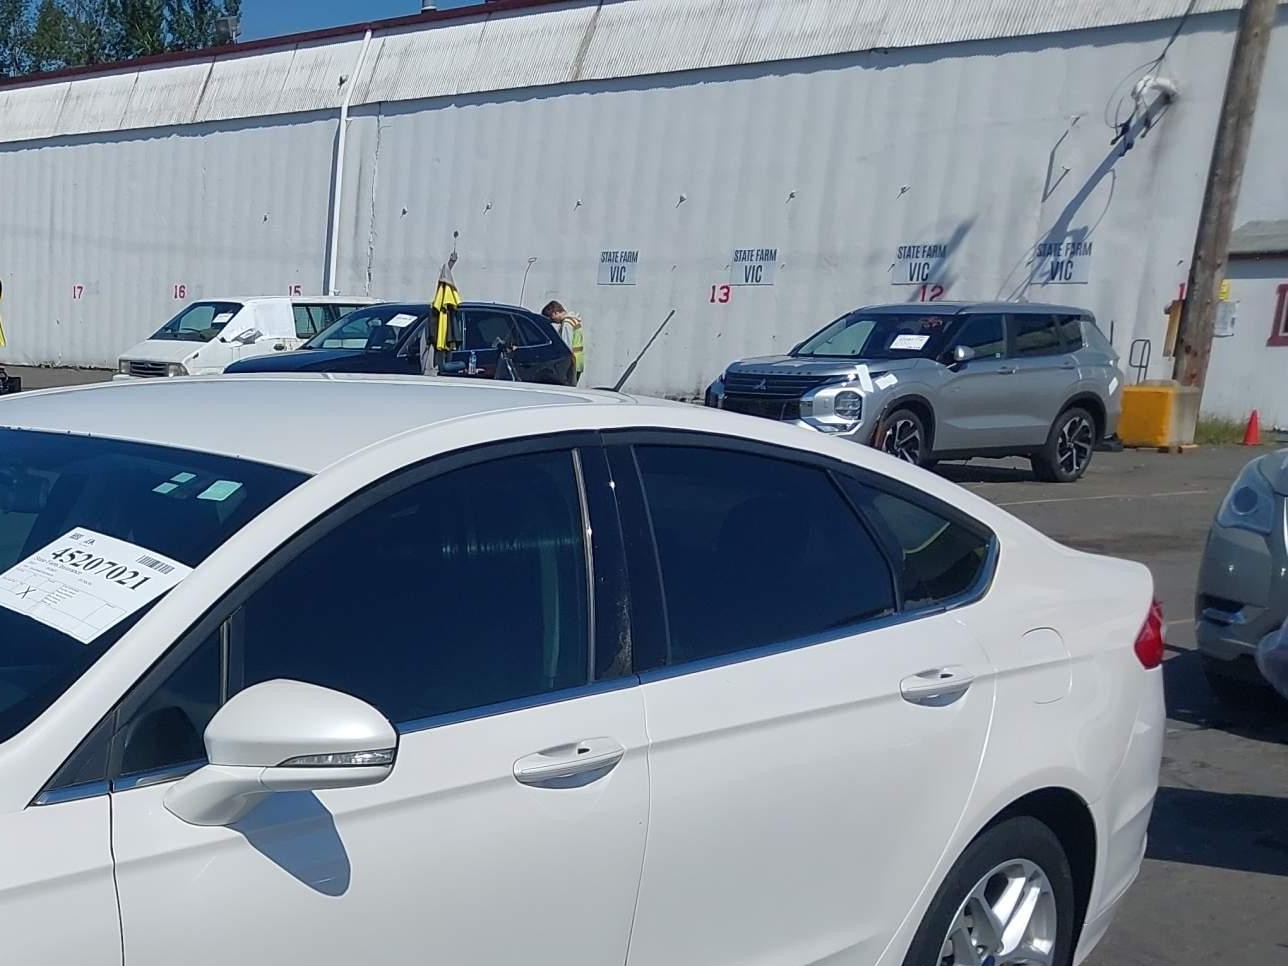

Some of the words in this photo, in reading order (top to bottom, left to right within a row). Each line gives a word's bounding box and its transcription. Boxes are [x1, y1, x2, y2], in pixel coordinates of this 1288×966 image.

[601, 251, 619, 263] STATE
[620, 251, 639, 263] FARM
[734, 250, 754, 262] STATE
[755, 249, 777, 262] FARM
[897, 245, 920, 259] STATE
[921, 245, 947, 258] FARM
[1037, 243, 1062, 257] STATE
[1065, 242, 1092, 257] FARM
[609, 265, 626, 283] VIC
[744, 264, 763, 283] VIC
[908, 262, 930, 282] VIC
[1050, 260, 1074, 281] VIC
[73, 285, 83, 299] 17
[174, 285, 186, 299] 16
[288, 285, 301, 297] 15
[710, 285, 731, 304] 13
[920, 284, 944, 302] 12
[51, 547, 152, 591] 45207021
